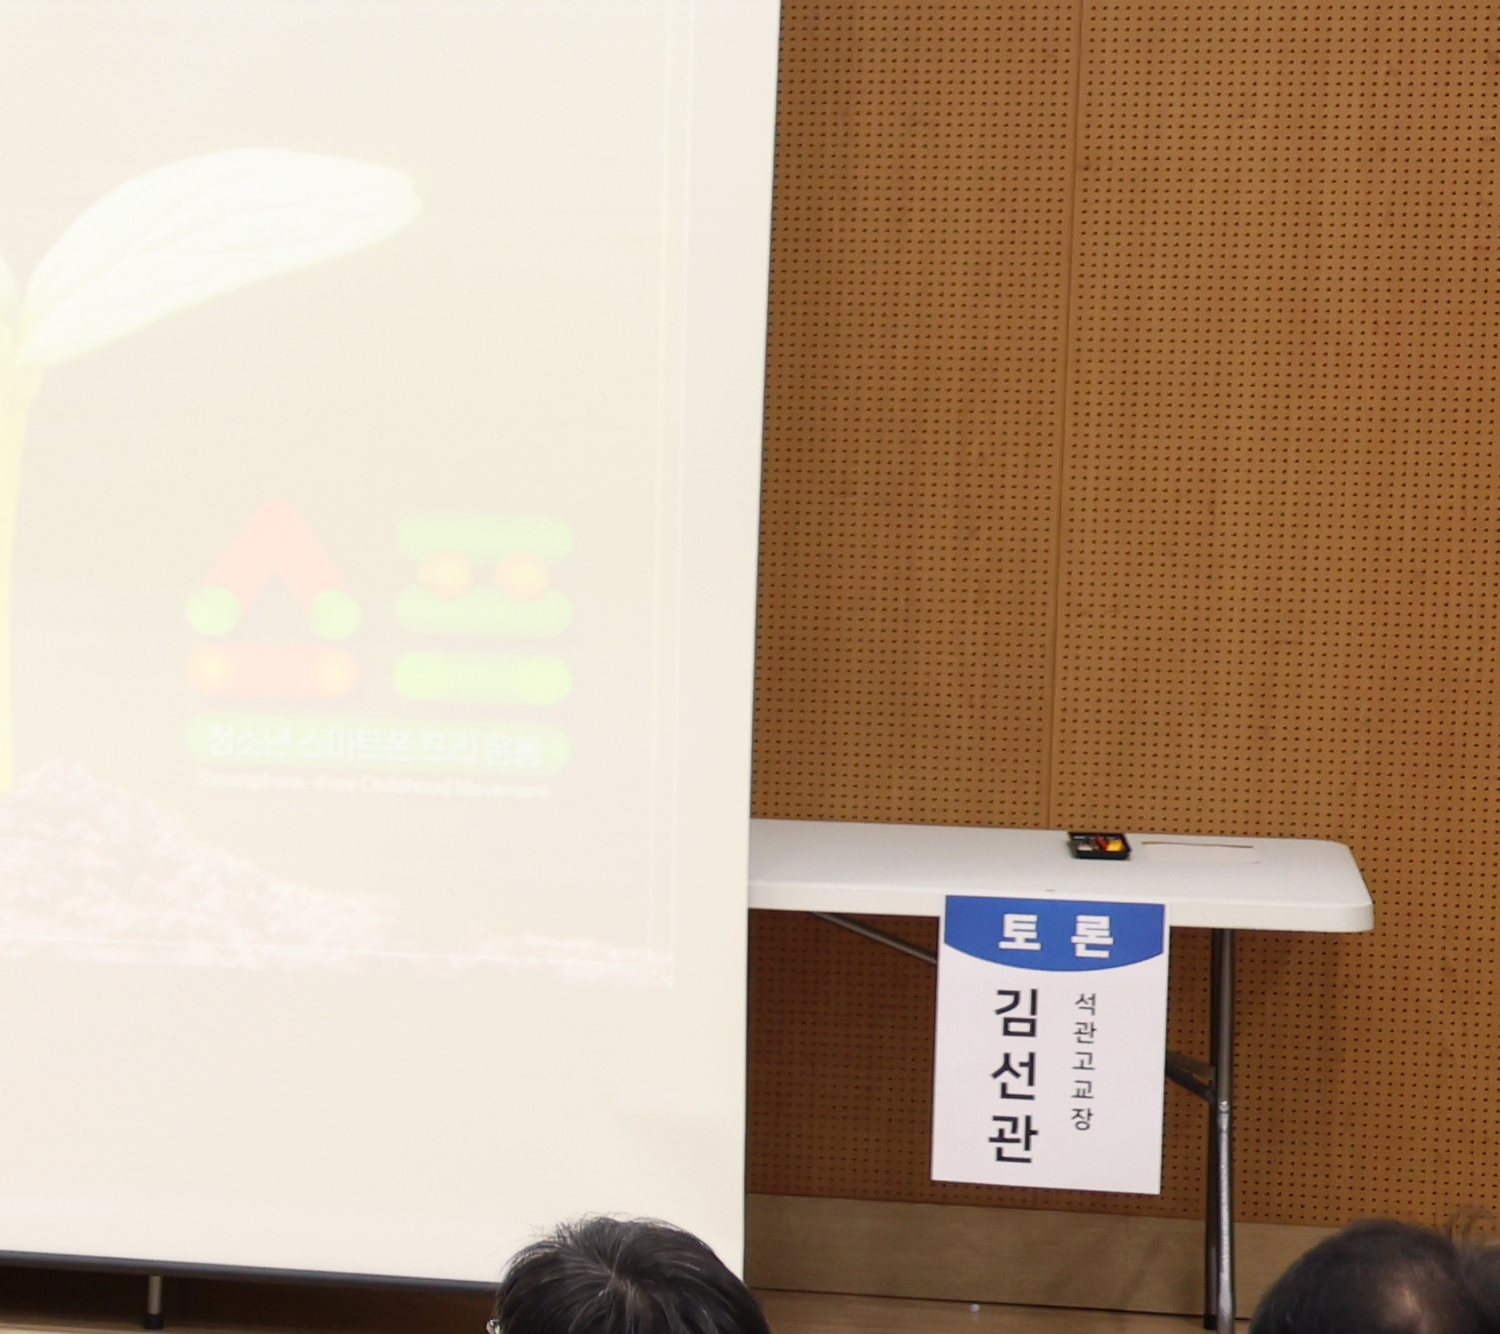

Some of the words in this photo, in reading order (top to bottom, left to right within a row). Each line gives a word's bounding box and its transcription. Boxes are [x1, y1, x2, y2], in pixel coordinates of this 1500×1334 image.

[208, 723, 291, 759] 청소년
[298, 728, 413, 764] 스마트폰
[420, 731, 479, 765] 프리
[999, 914, 1114, 958] 토론
[988, 988, 1039, 1164] 김선관
[1071, 992, 1098, 1131] 석관고교장
